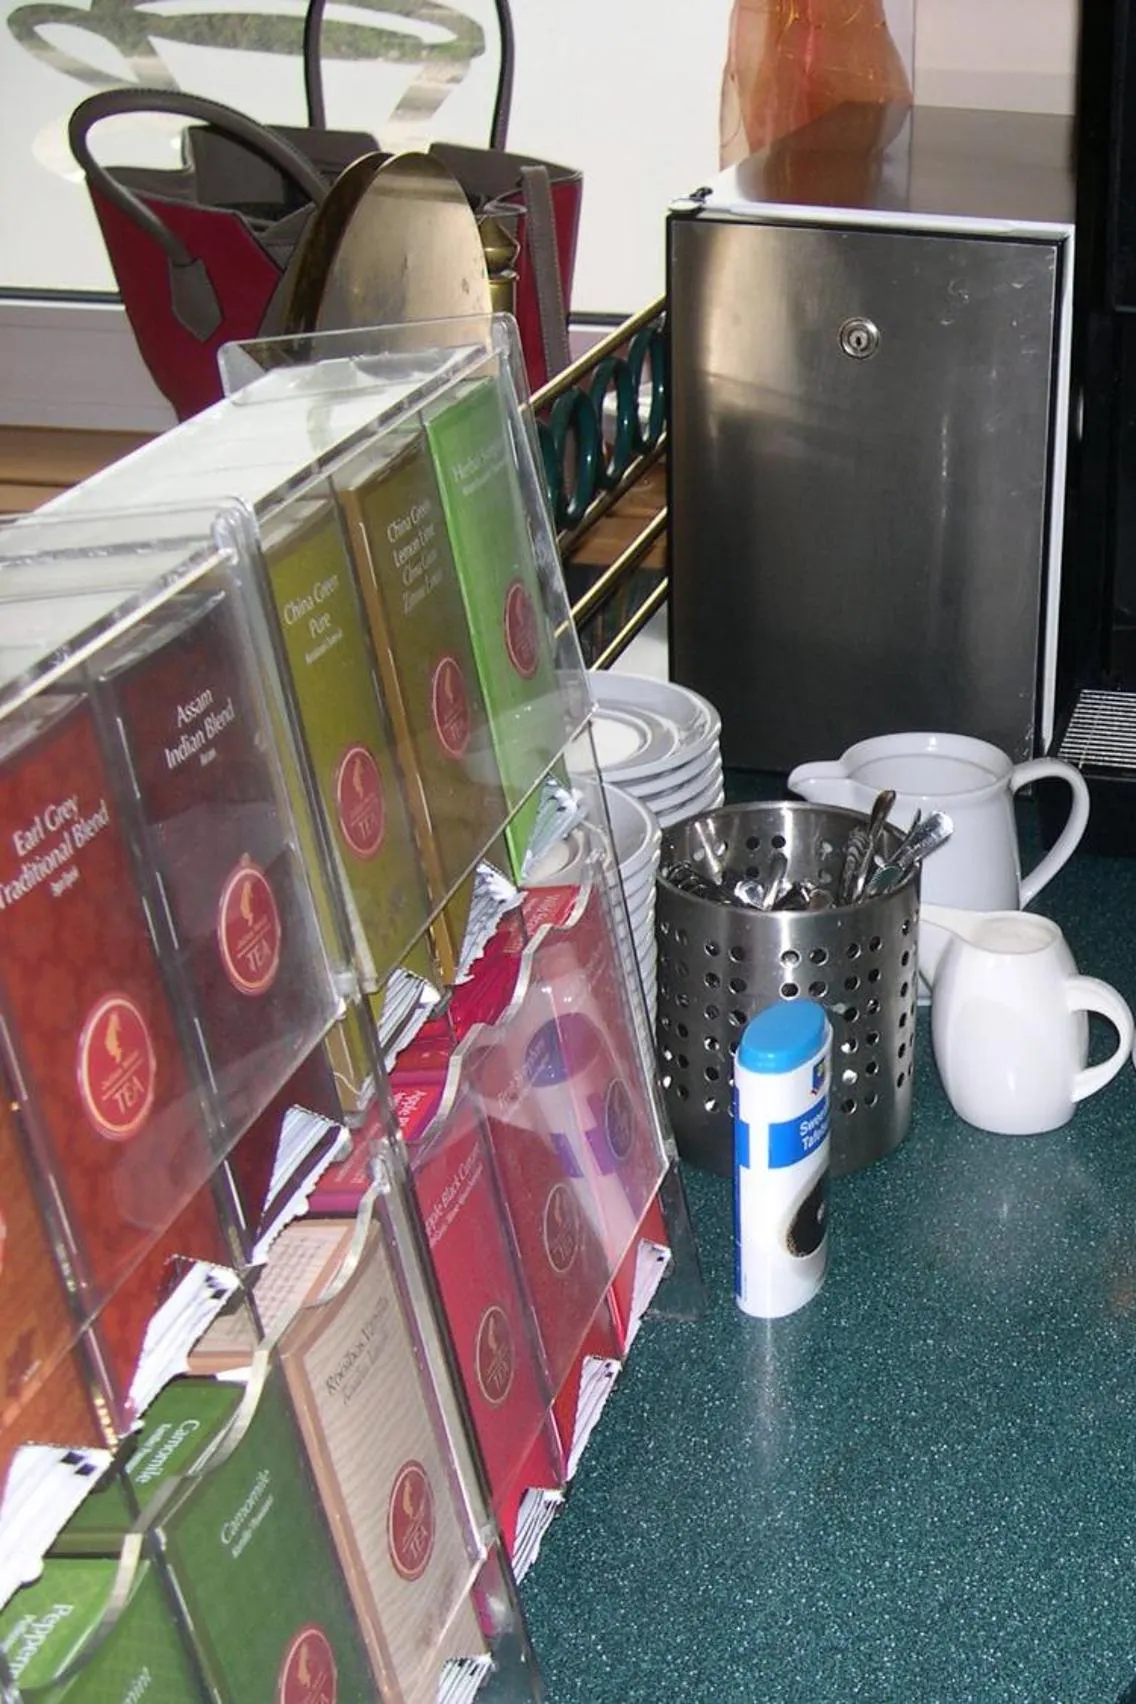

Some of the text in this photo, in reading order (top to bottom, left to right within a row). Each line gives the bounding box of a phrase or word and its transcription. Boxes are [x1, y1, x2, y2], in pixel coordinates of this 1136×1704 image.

[284, 574, 339, 625] China Green
[164, 729, 206, 770] Indian
[203, 696, 235, 741] Blend
[177, 688, 213, 729] Assam
[13, 793, 79, 858] Earl Grey
[71, 798, 110, 849] Blend
[112, 1075, 146, 1115] TEA
[134, 1418, 200, 1485] Camomile
[220, 1469, 270, 1546] Camomile
[8, 1603, 75, 1683] Pepperm
